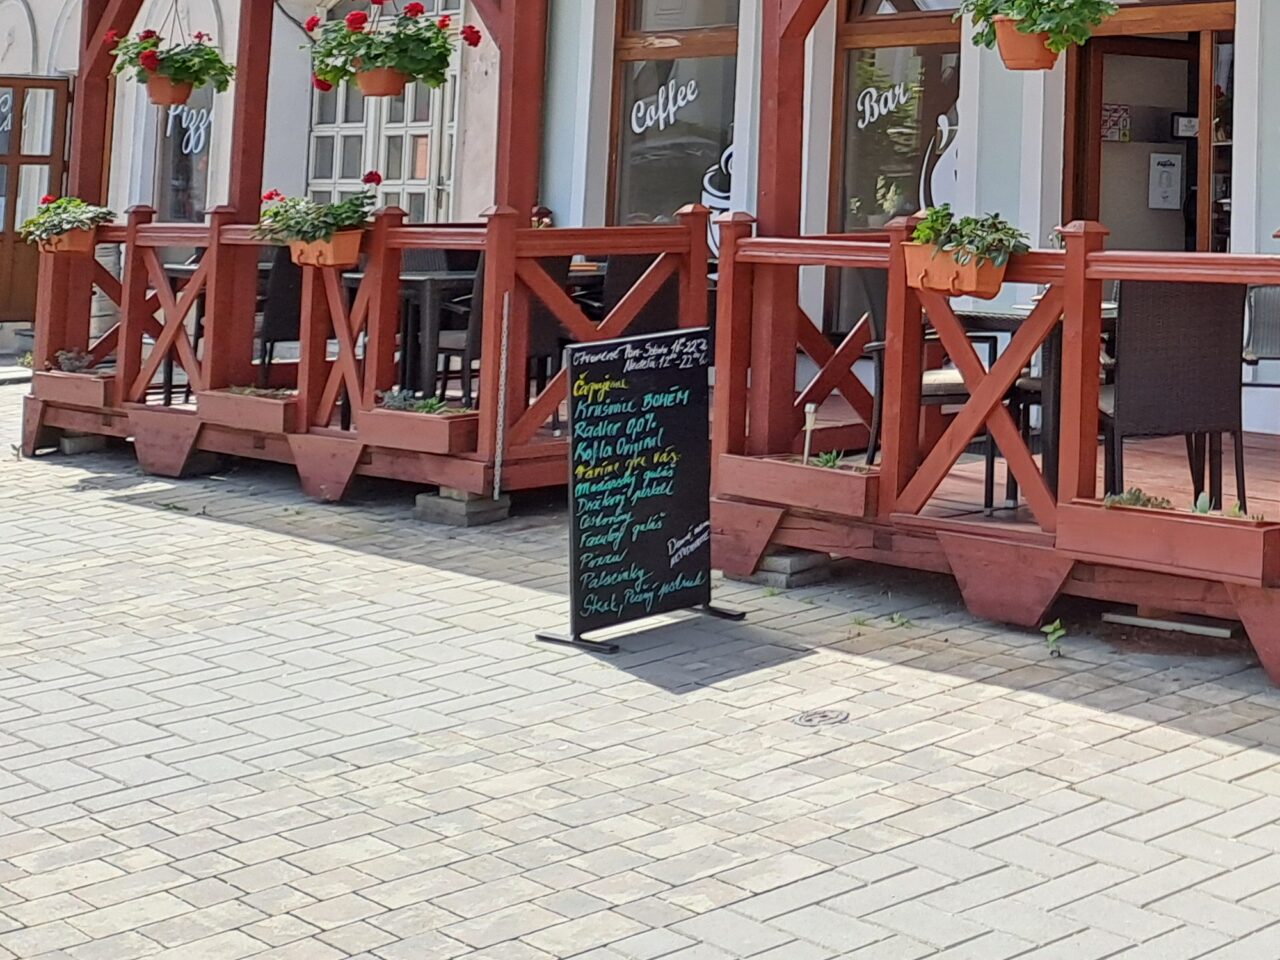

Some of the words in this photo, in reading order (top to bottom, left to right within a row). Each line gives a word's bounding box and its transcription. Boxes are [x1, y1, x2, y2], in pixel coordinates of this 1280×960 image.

[166, 104, 214, 154] Pizz
[630, 77, 698, 134] Coffee
[856, 82, 909, 129] Bar
[574, 420, 621, 438] Radler
